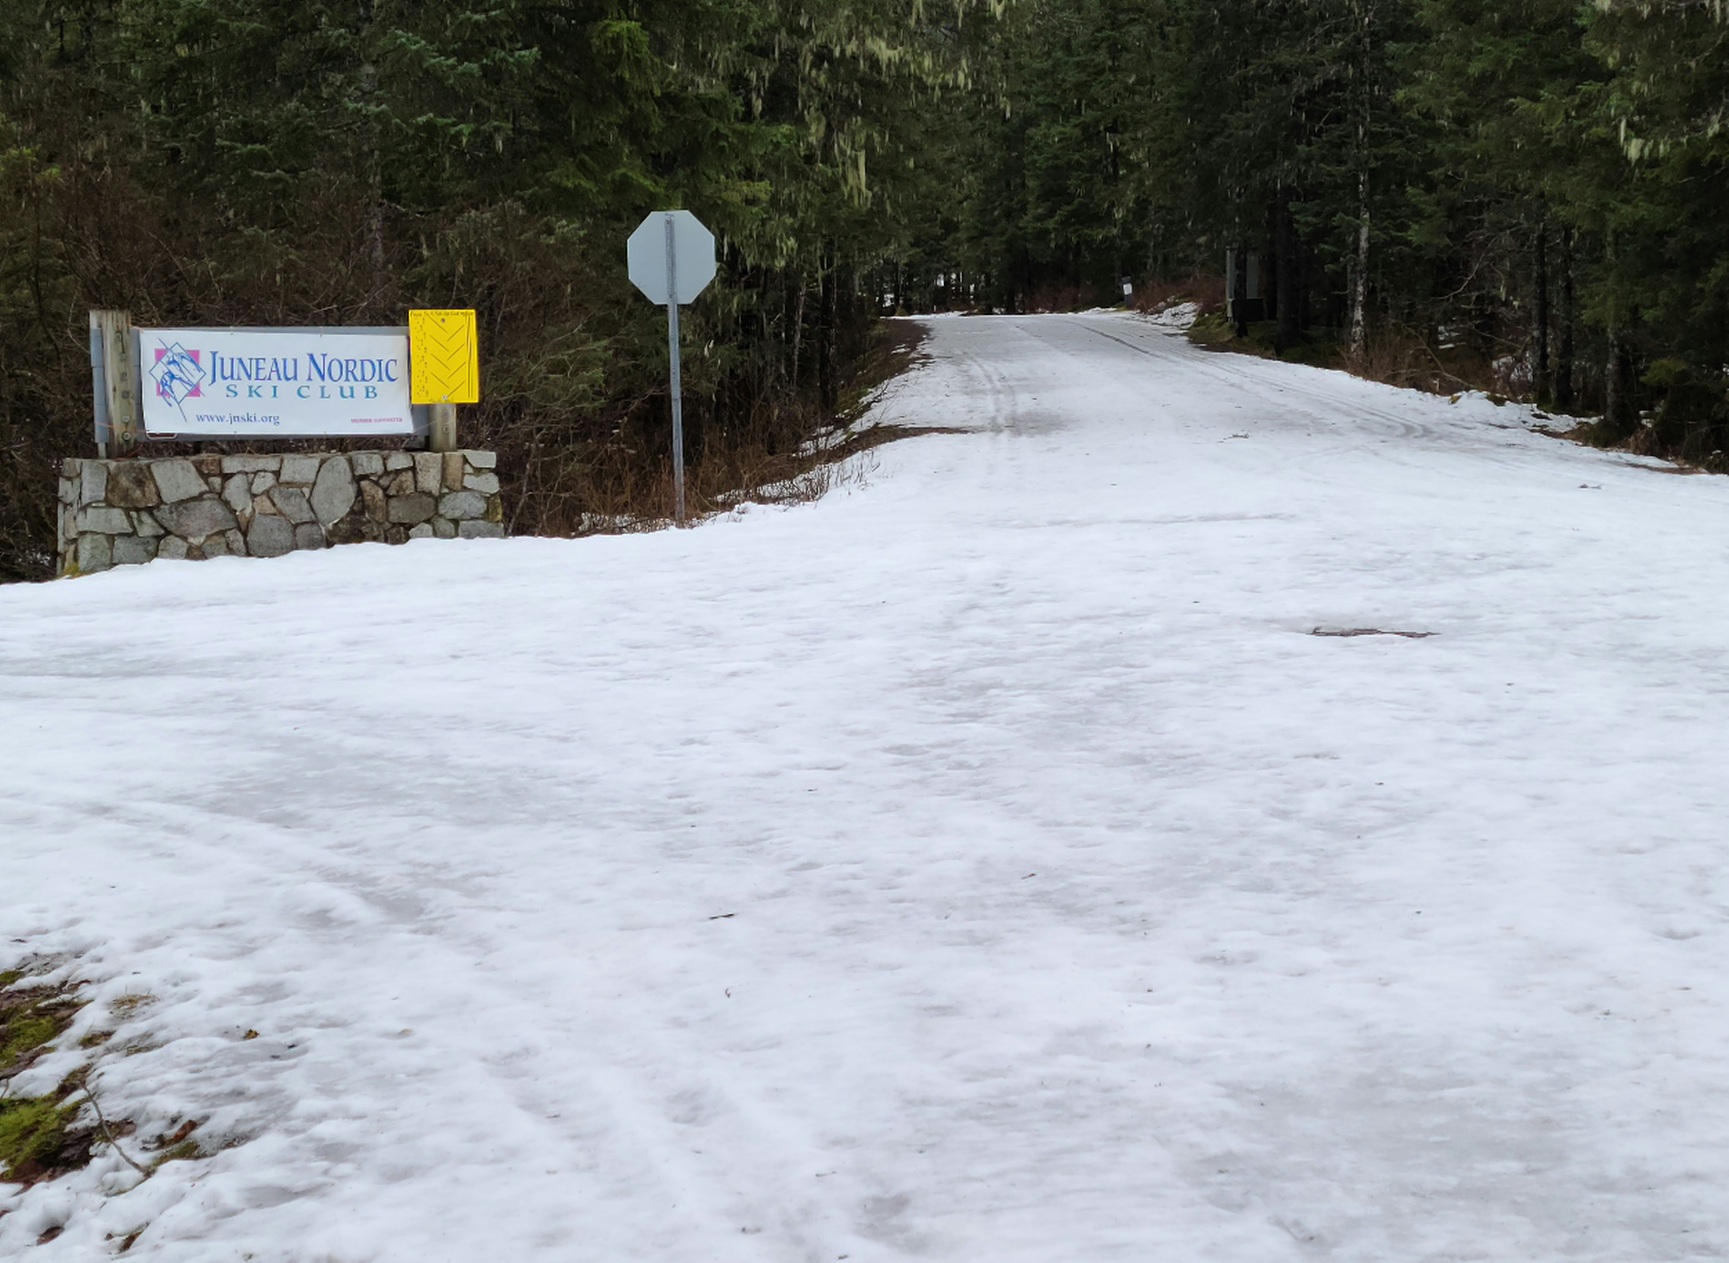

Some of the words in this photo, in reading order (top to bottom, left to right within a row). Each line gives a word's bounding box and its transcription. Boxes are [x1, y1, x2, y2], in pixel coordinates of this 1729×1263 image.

[208, 351, 298, 387] JUNEAU
[307, 353, 399, 383] NORDIC
[226, 384, 279, 398] SKI
[296, 385, 378, 399] CLUB
[195, 413, 281, 426] www.jnski.org
